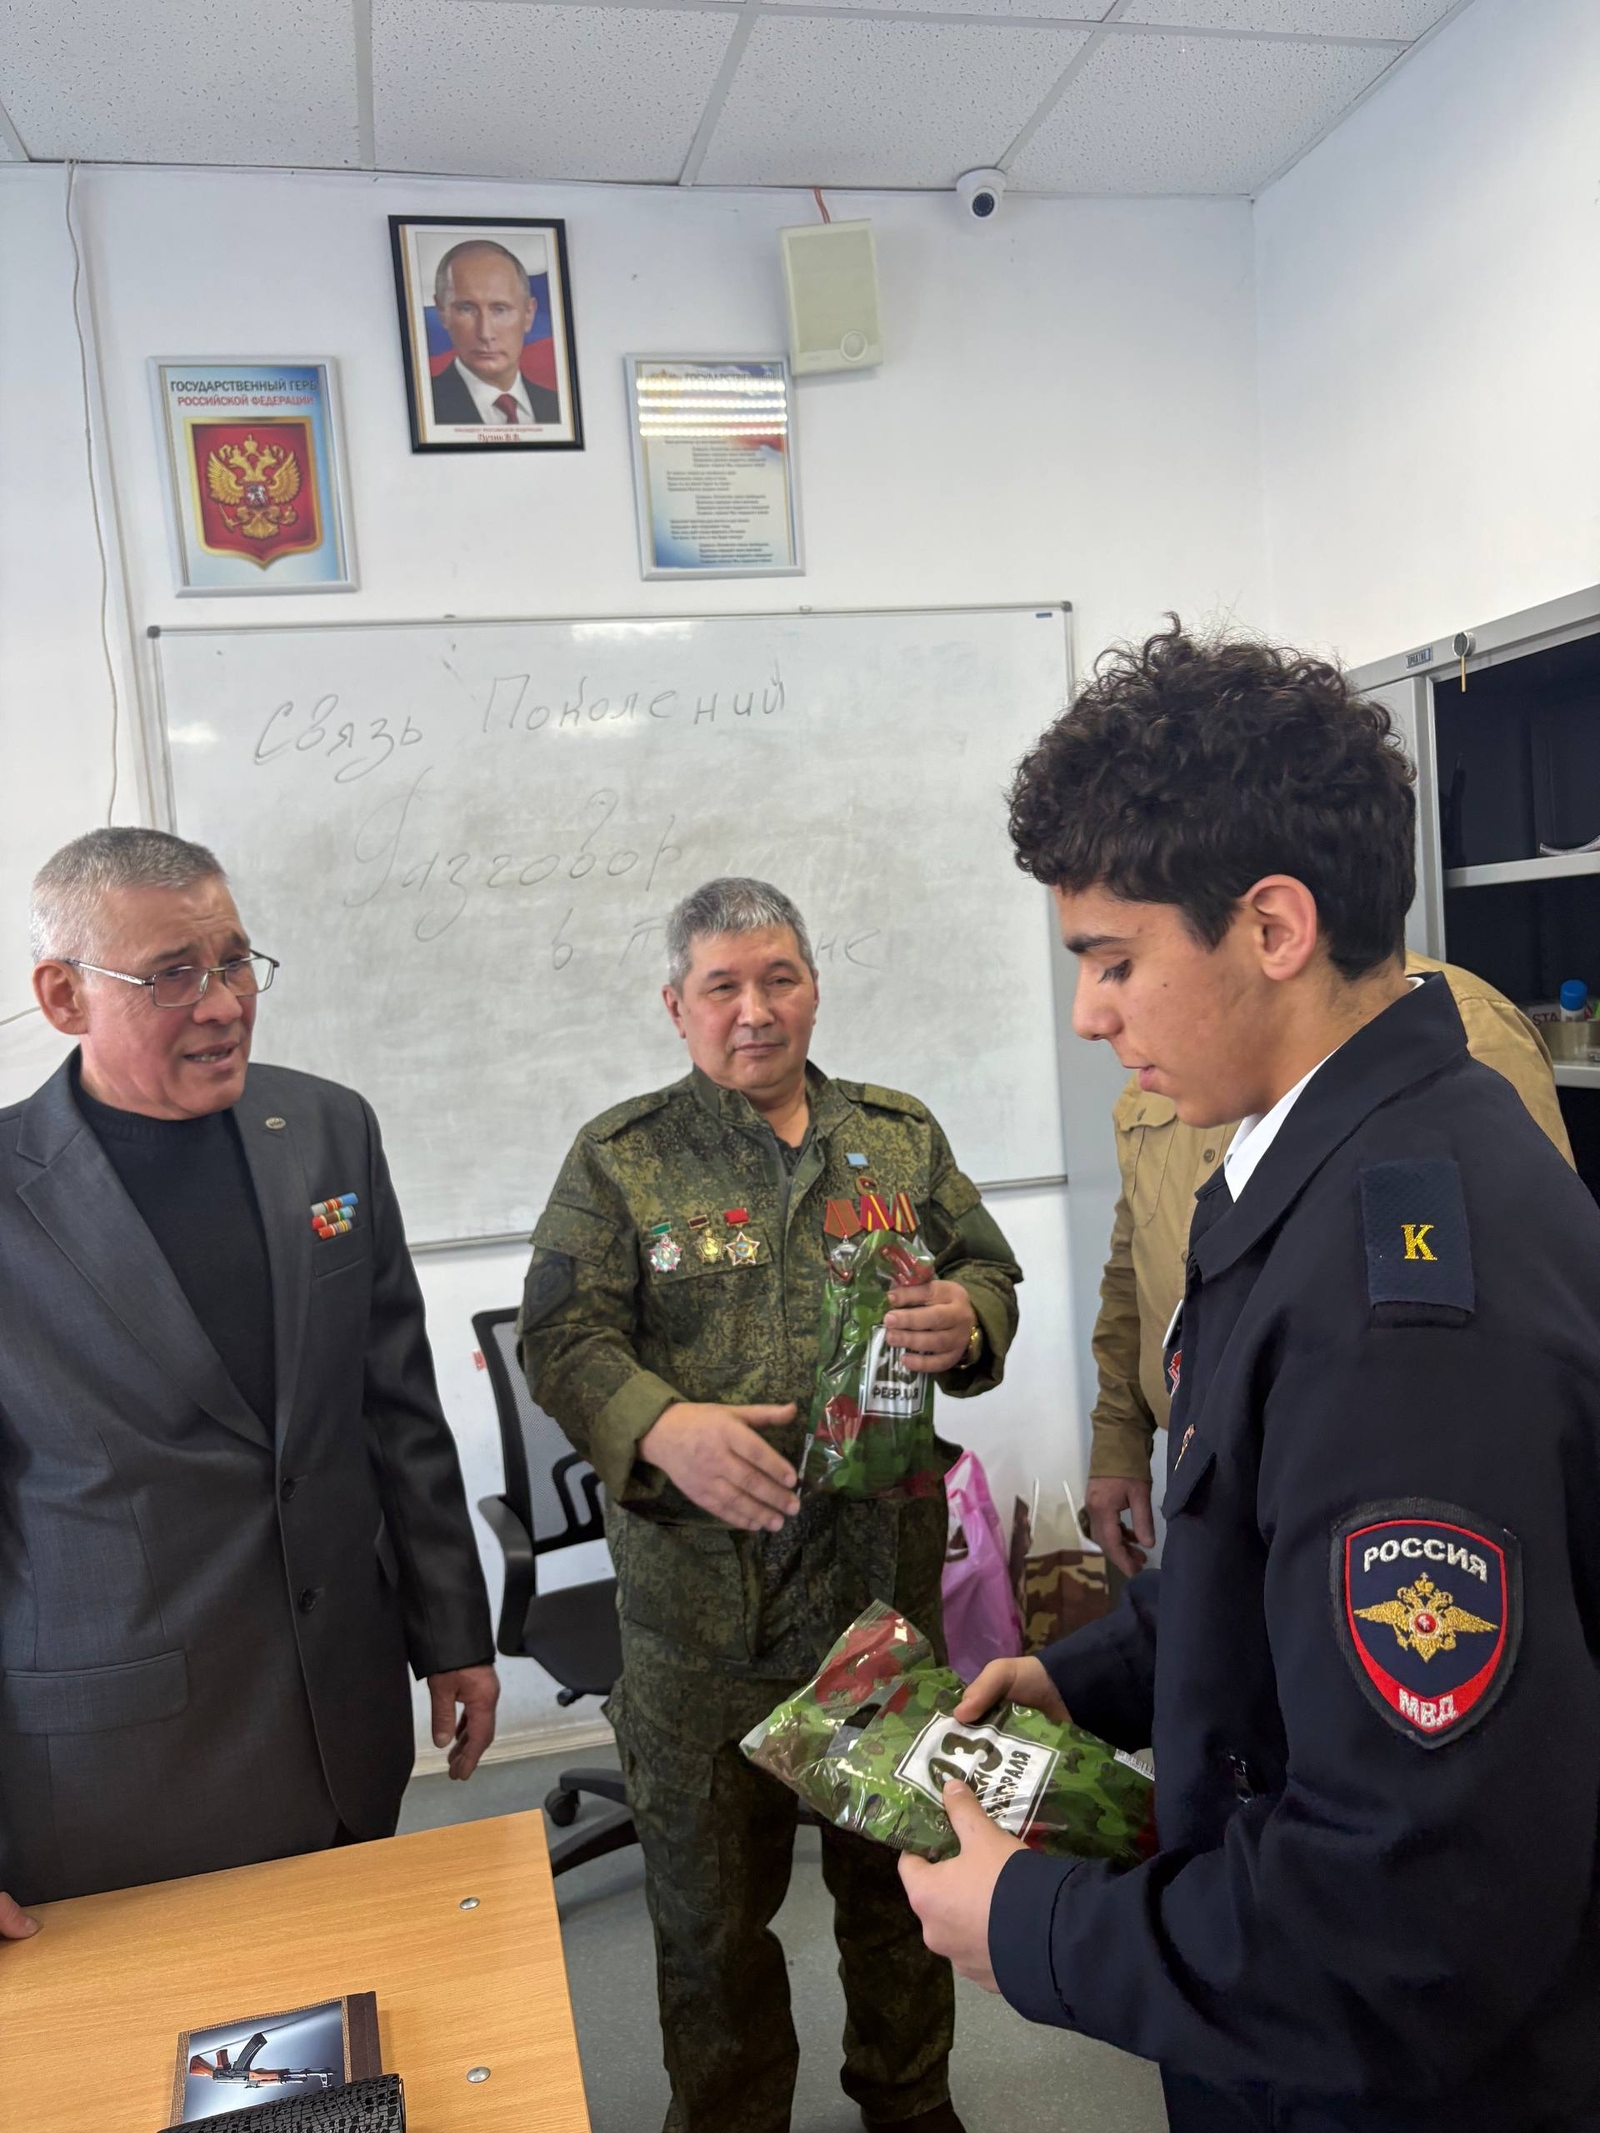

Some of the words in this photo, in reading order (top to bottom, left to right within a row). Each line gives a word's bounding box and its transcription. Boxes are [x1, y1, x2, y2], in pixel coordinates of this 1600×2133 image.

[170, 378, 287, 393] ГОСУДАРСТВЕННЫЙ
[177, 394, 249, 406] РОССИЙСКОЙ
[251, 395, 314, 406] ФЕДЕРАЦИИ
[255, 693, 423, 783] Связь
[482, 660, 787, 733] Поколений
[1400, 1224, 1438, 1261] К
[1363, 1537, 1488, 1583] РОССИЯ
[1398, 1688, 1458, 1728] МВД
